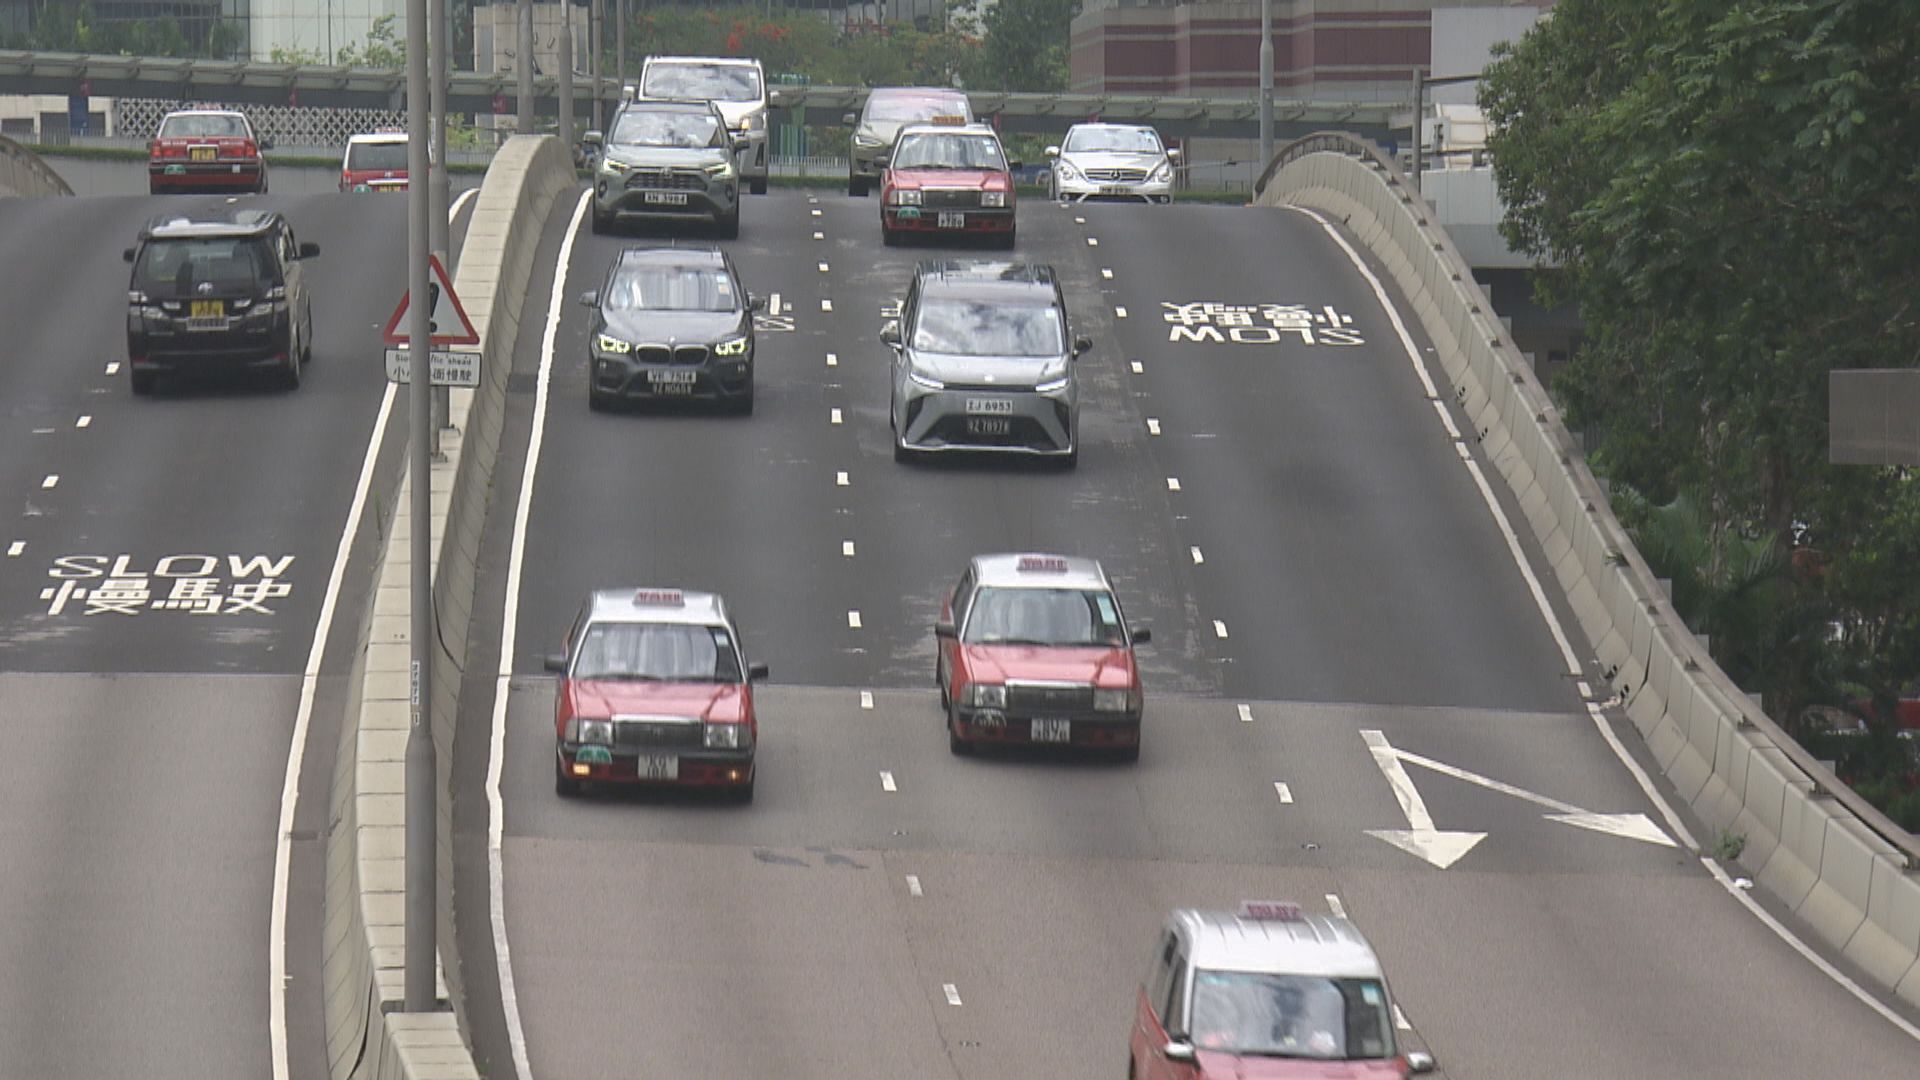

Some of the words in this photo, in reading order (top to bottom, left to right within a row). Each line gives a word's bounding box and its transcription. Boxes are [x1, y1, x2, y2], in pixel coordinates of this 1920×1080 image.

[1160, 301, 1353, 328] 慢駛
[1168, 325, 1365, 345] SLOW
[48, 554, 296, 577] SLOW
[40, 578, 292, 615] 慢駛
